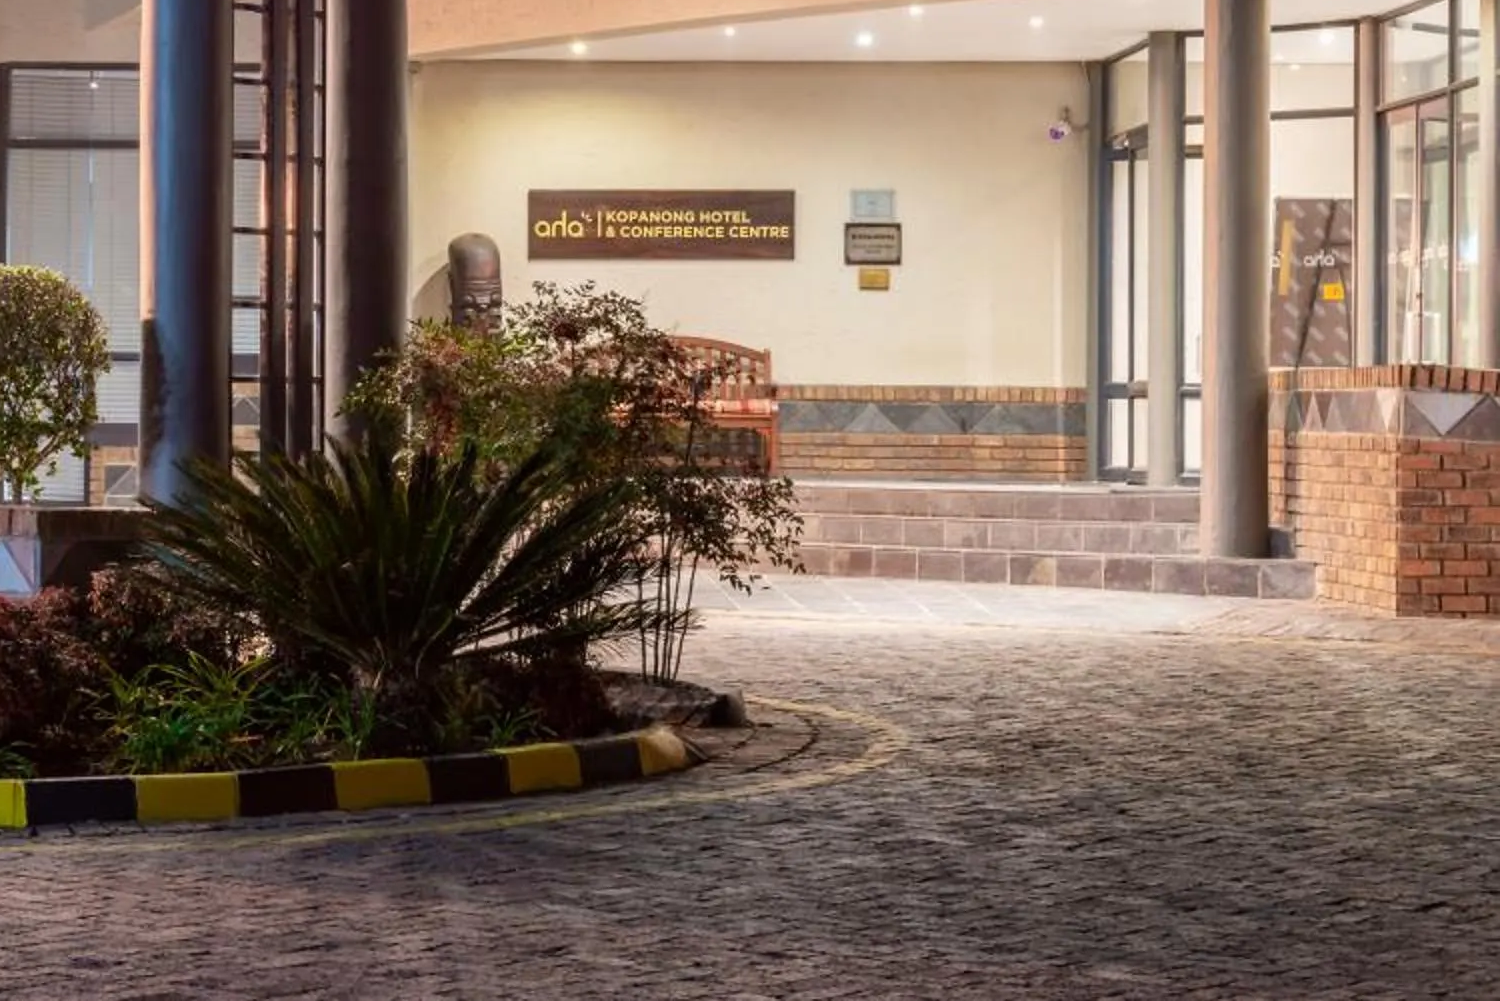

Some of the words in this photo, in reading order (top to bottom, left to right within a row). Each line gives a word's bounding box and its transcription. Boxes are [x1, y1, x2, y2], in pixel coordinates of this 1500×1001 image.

[605, 210, 695, 224] KOPANONG
[699, 210, 751, 224] HOTEL
[605, 225, 616, 238] &
[619, 225, 725, 238] CONFERENCE
[728, 225, 790, 238] CENTRE
